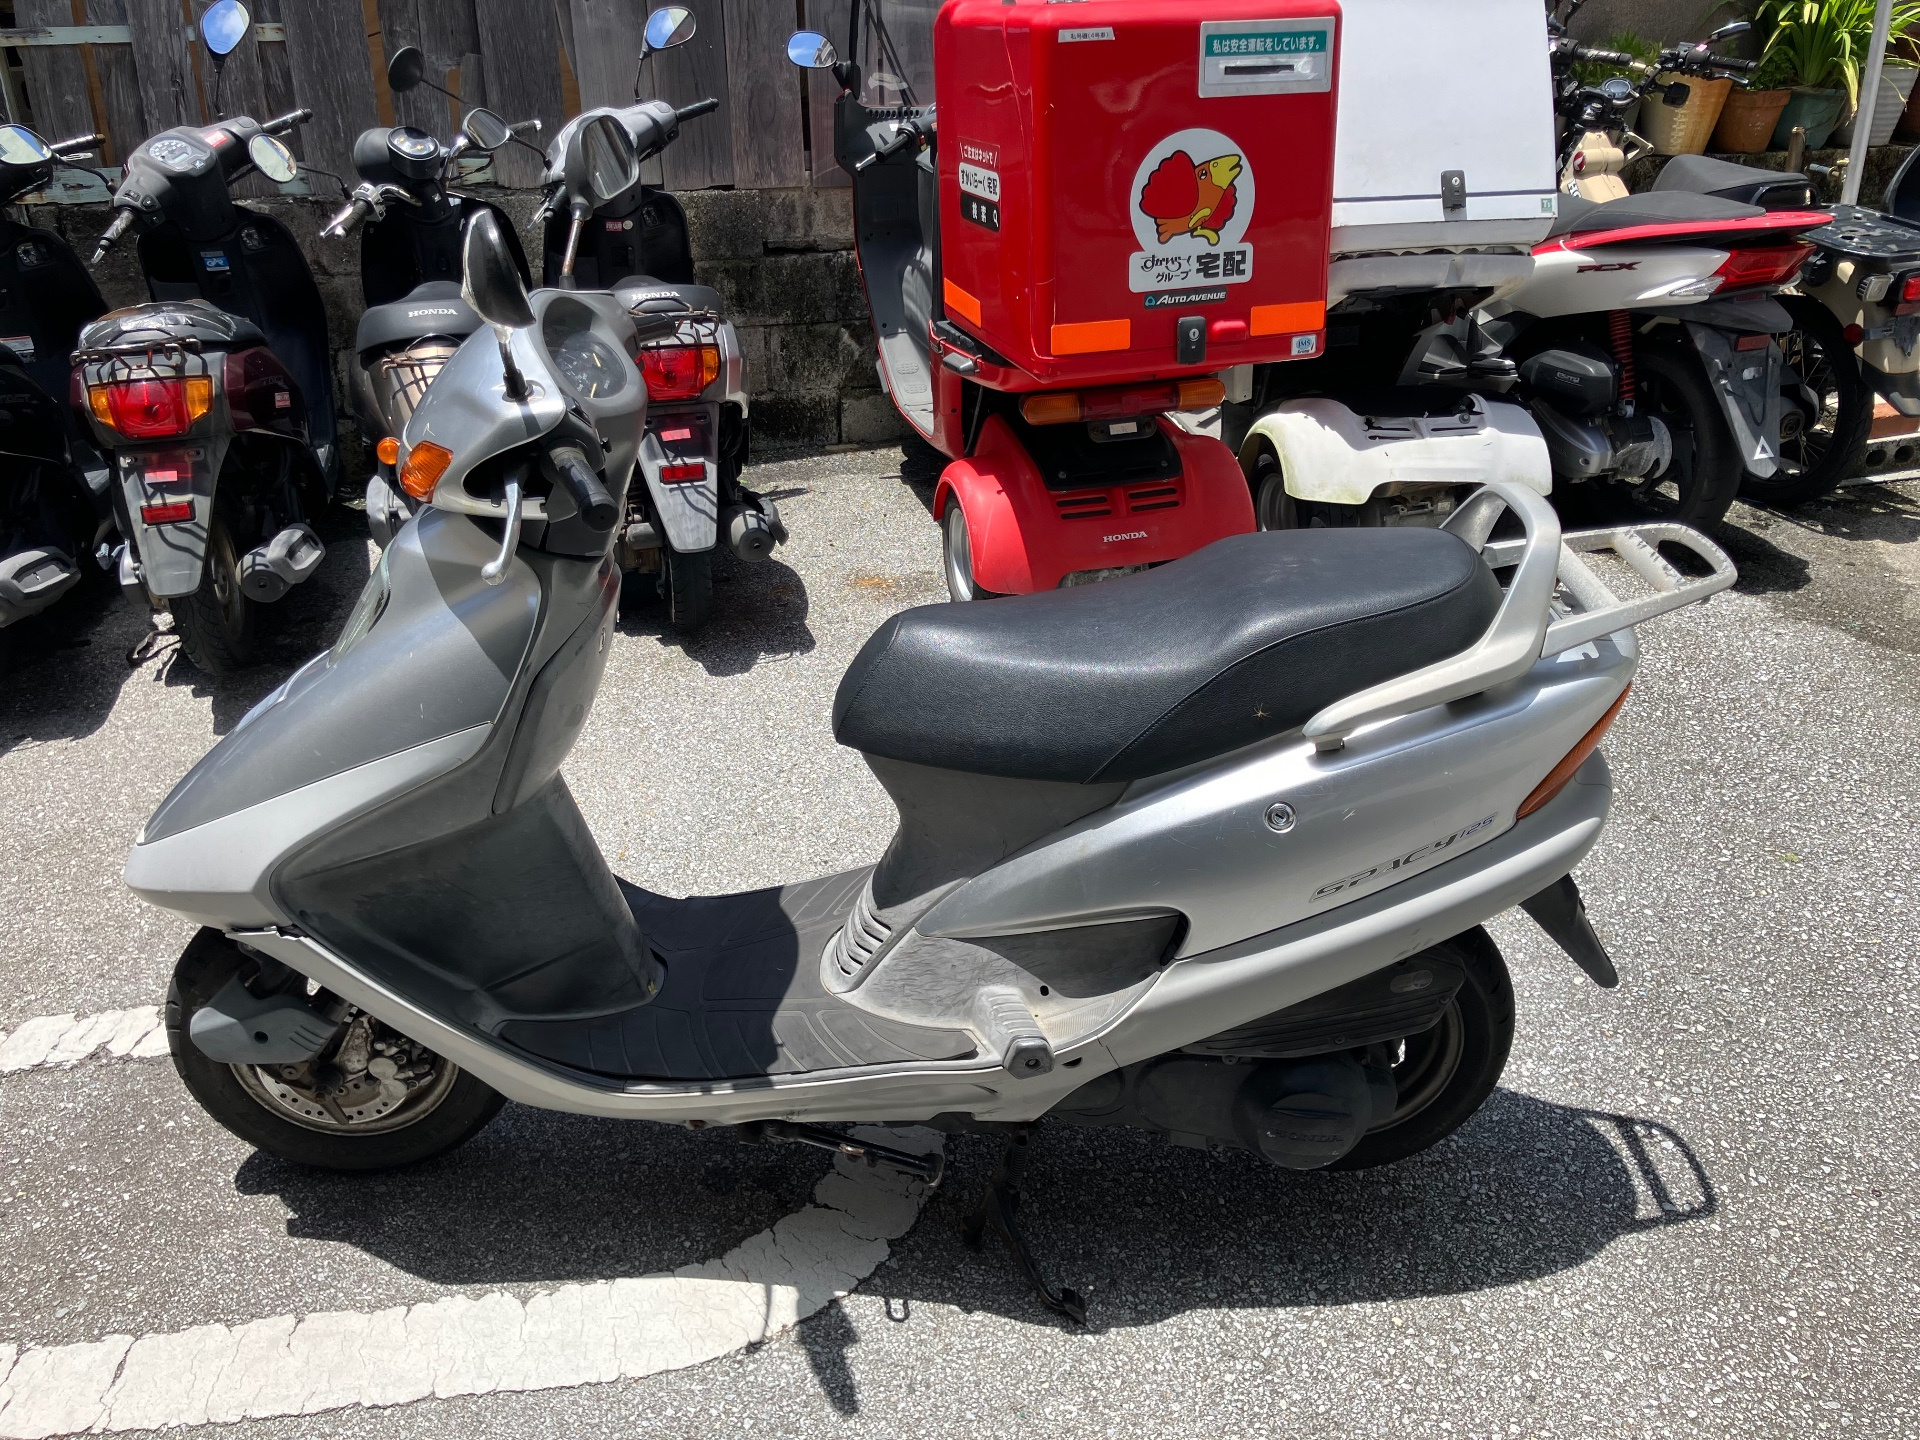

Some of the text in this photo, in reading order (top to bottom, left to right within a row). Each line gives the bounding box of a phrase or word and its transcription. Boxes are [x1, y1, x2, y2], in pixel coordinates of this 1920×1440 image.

[1212, 36, 1320, 53] 私は安全運転をしています。
[1196, 249, 1247, 279] 宅配
[1576, 261, 1643, 273] PCX
[1155, 269, 1192, 284] グループ
[631, 291, 681, 301] HONDA
[1156, 291, 1227, 306] AUTO AVENUE
[407, 308, 459, 318] HONDA
[1103, 531, 1148, 542] HONDA
[1311, 814, 1495, 901] SPACY 125
